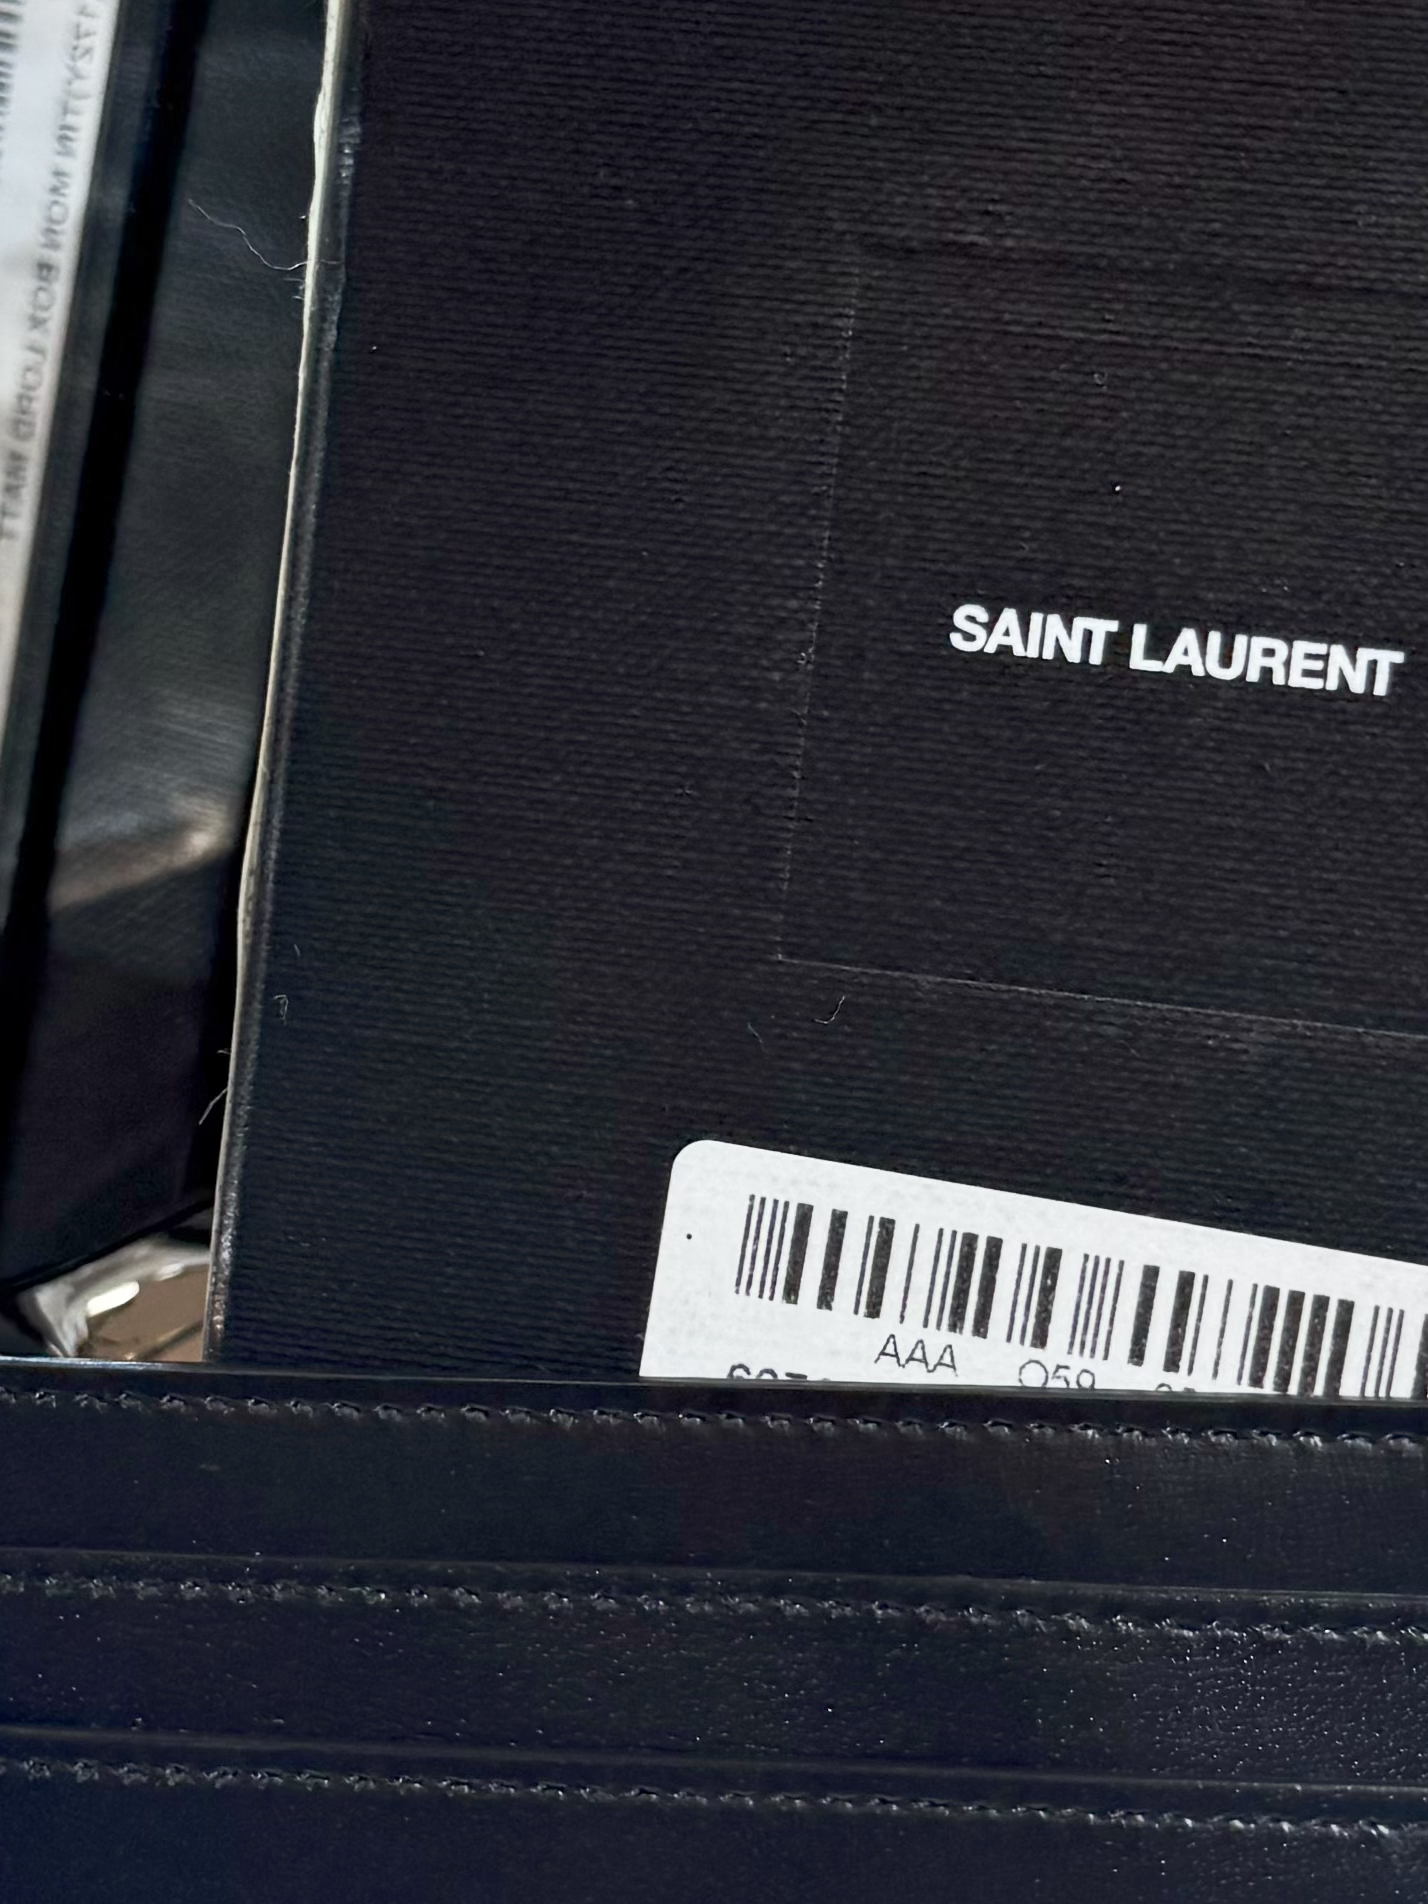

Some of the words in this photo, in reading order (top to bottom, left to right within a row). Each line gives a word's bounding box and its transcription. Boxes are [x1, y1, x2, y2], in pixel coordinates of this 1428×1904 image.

[949, 603, 1119, 666] SAINT
[1128, 623, 1406, 696] LAURENT
[873, 1333, 958, 1377] AAA
